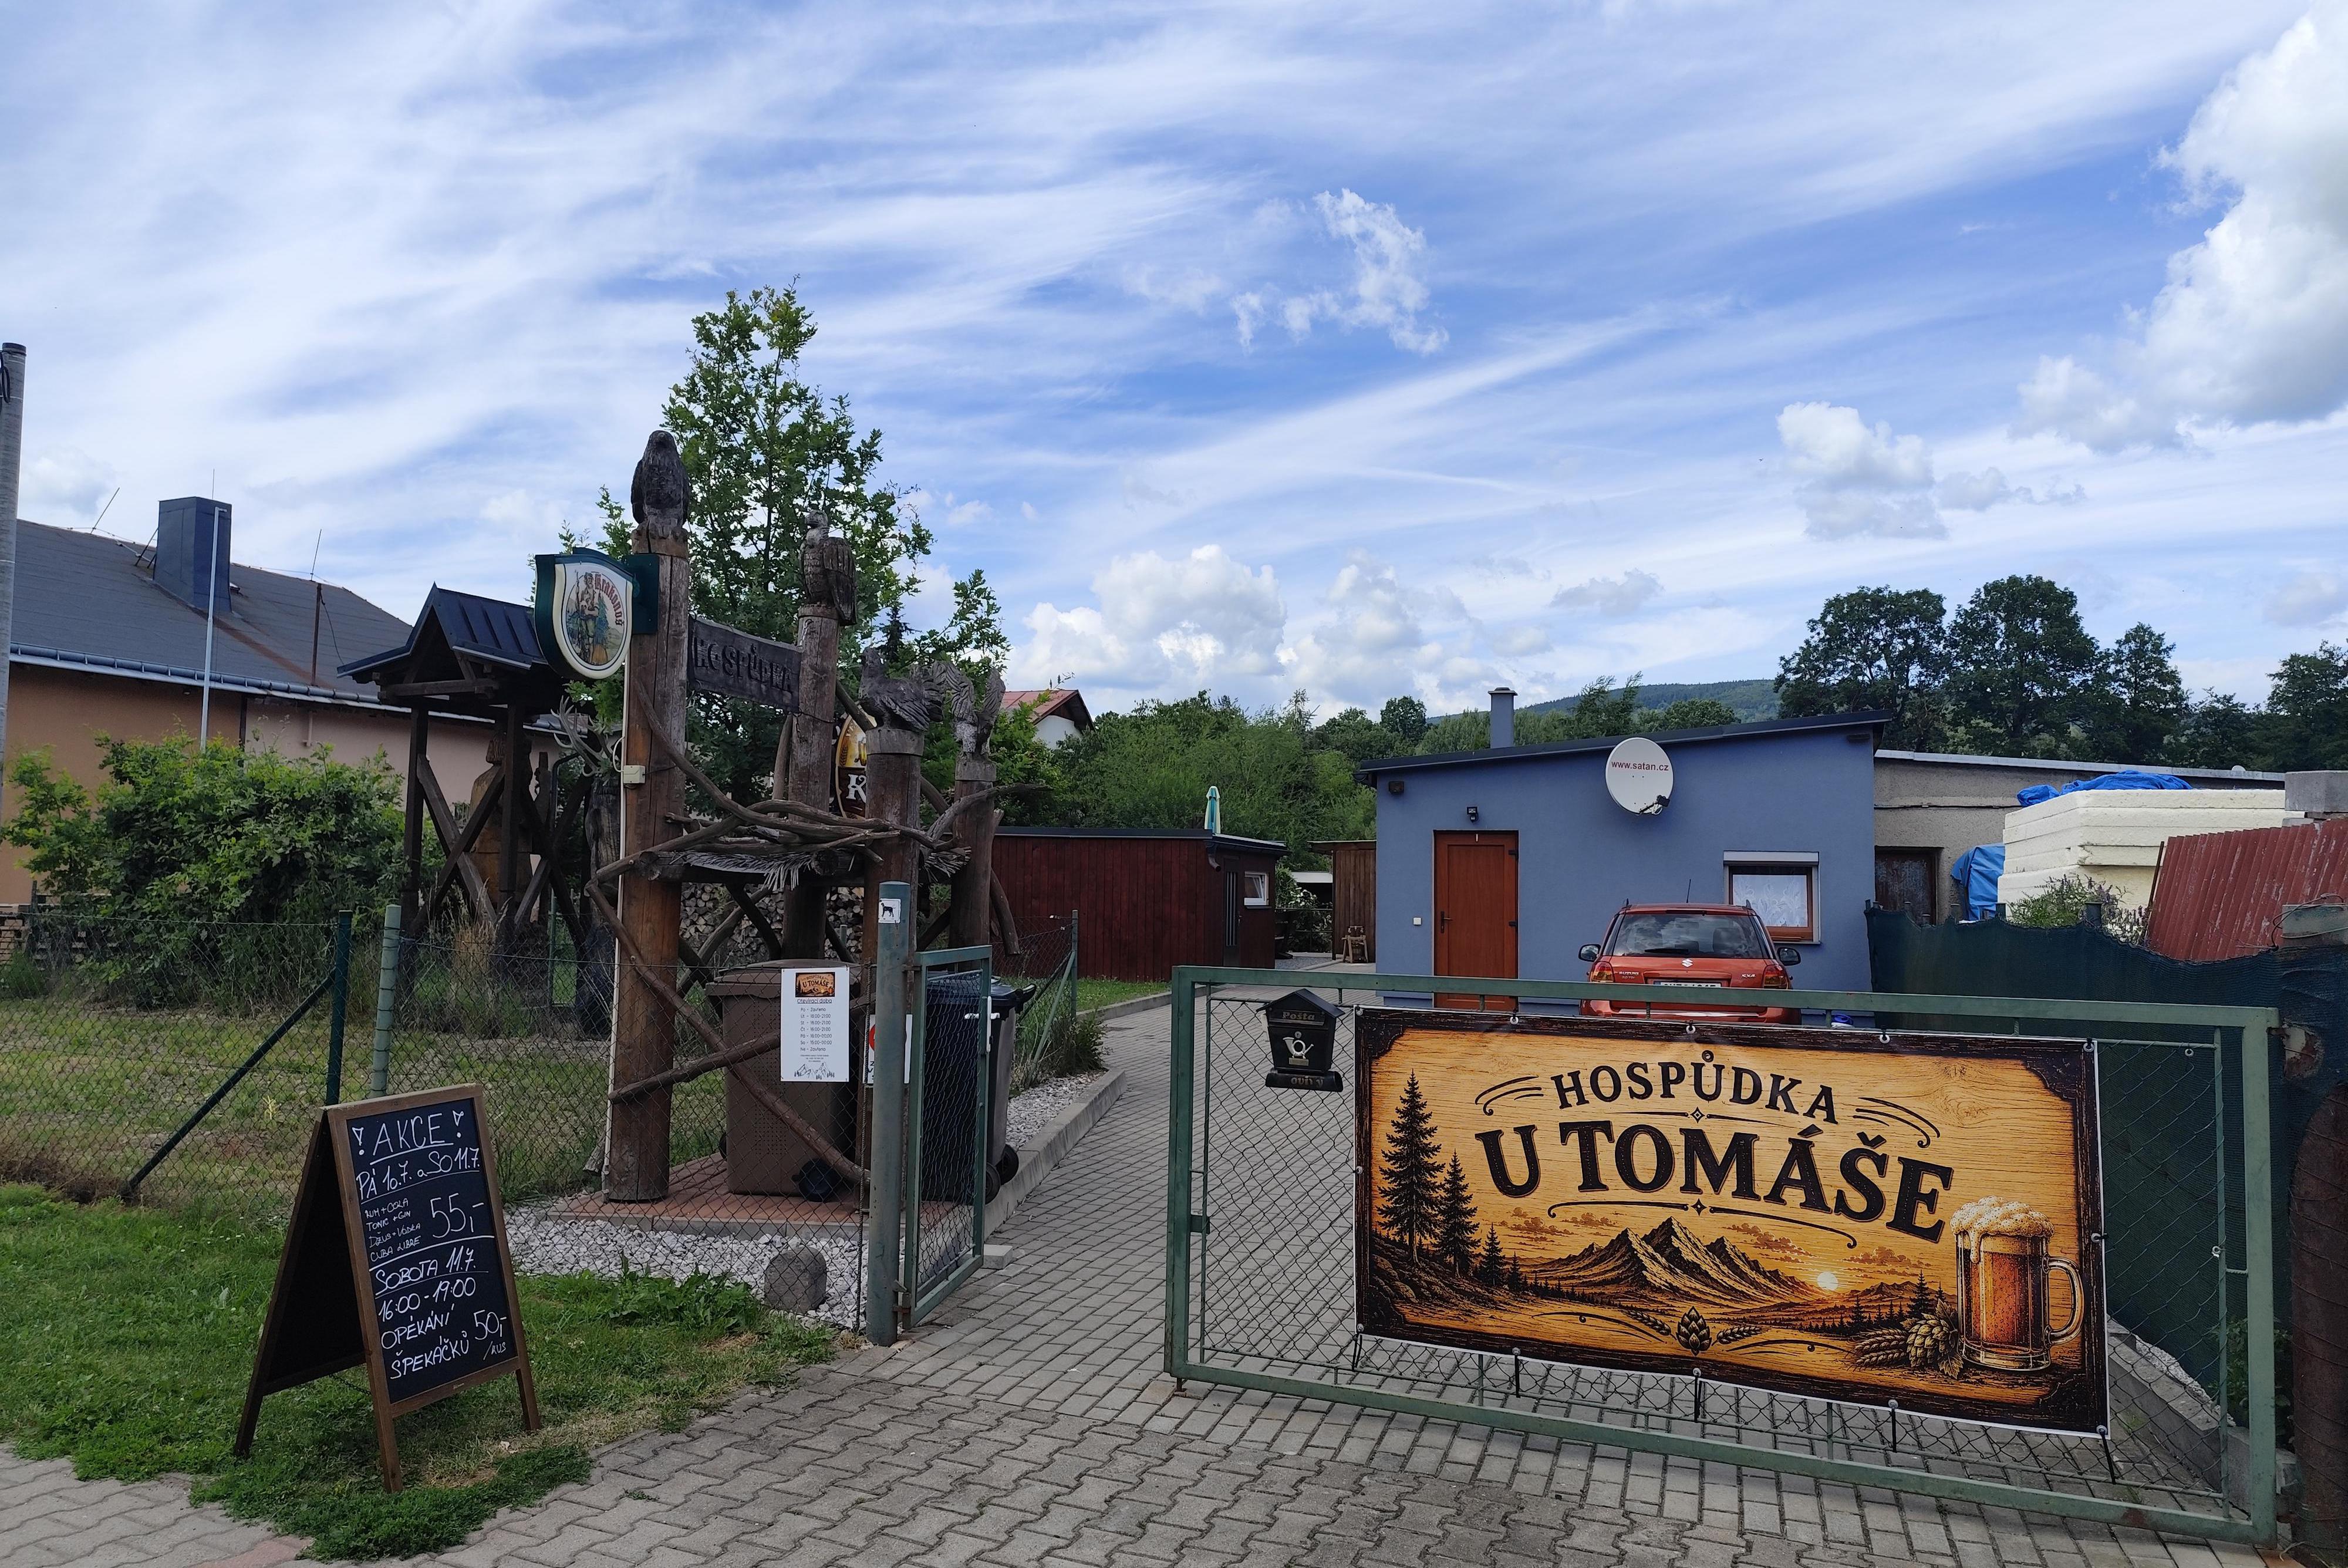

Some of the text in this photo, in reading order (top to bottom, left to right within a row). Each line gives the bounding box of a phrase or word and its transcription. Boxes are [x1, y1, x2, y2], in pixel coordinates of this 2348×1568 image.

[1611, 761, 1669, 771] www.satan.cz
[1283, 1011, 1315, 1020] Pošta
[1550, 1050, 1838, 1125] HOSPŮDKA
[373, 1113, 445, 1156] AKCE
[356, 1168, 377, 1200] PÁ
[382, 1161, 412, 1191] 10.7.
[428, 1151, 453, 1173] SO
[454, 1147, 480, 1169] 11.7.
[1475, 1120, 1954, 1244] U TOMÁŠE
[366, 1218, 389, 1232] TONIC
[370, 1236, 421, 1262] CUBA LIBRE
[375, 1246, 476, 1296] SOBOTA 11.7.
[382, 1303, 455, 1349] OPÉKÁNÍ
[390, 1330, 469, 1380] ŠPEKÁČKŮ
